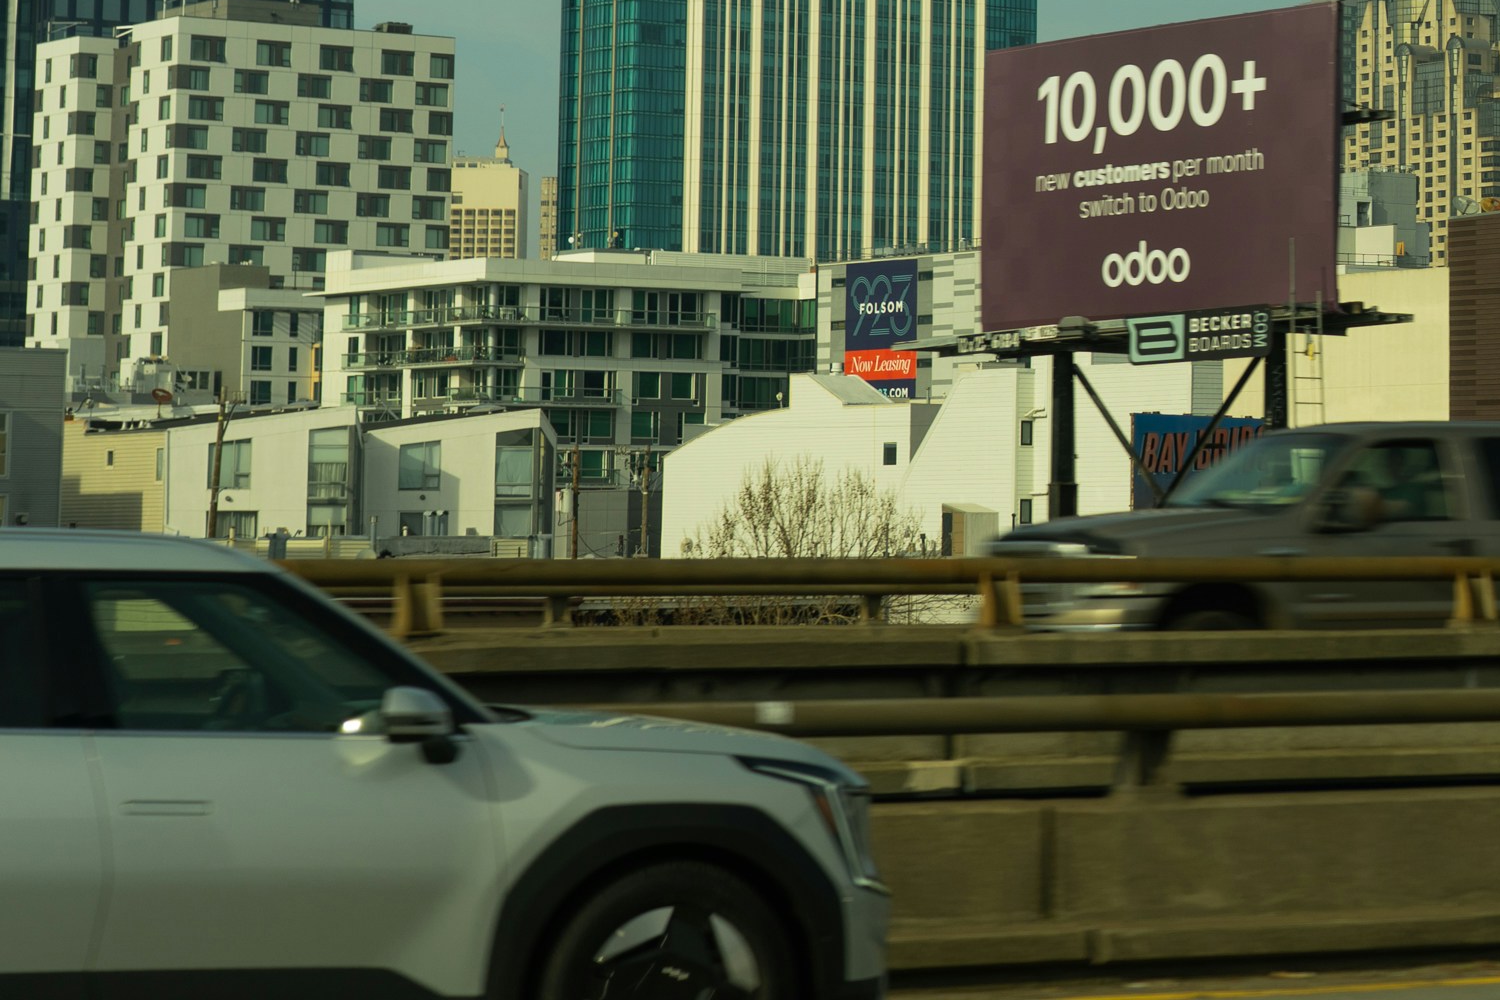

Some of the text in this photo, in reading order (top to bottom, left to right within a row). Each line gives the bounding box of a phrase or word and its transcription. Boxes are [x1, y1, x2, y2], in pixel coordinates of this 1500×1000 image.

[1037, 53, 1267, 154] 10,000+
[1035, 148, 1264, 192] new customers per month
[1079, 187, 1210, 219] switch to Odoo
[1101, 240, 1191, 288] odoo
[859, 300, 903, 315] FOLSOM
[1188, 313, 1252, 333] BECKER
[1188, 333, 1252, 352] BOARDS
[851, 355, 911, 374] Now Leasing
[1139, 432, 1189, 475] BAY
